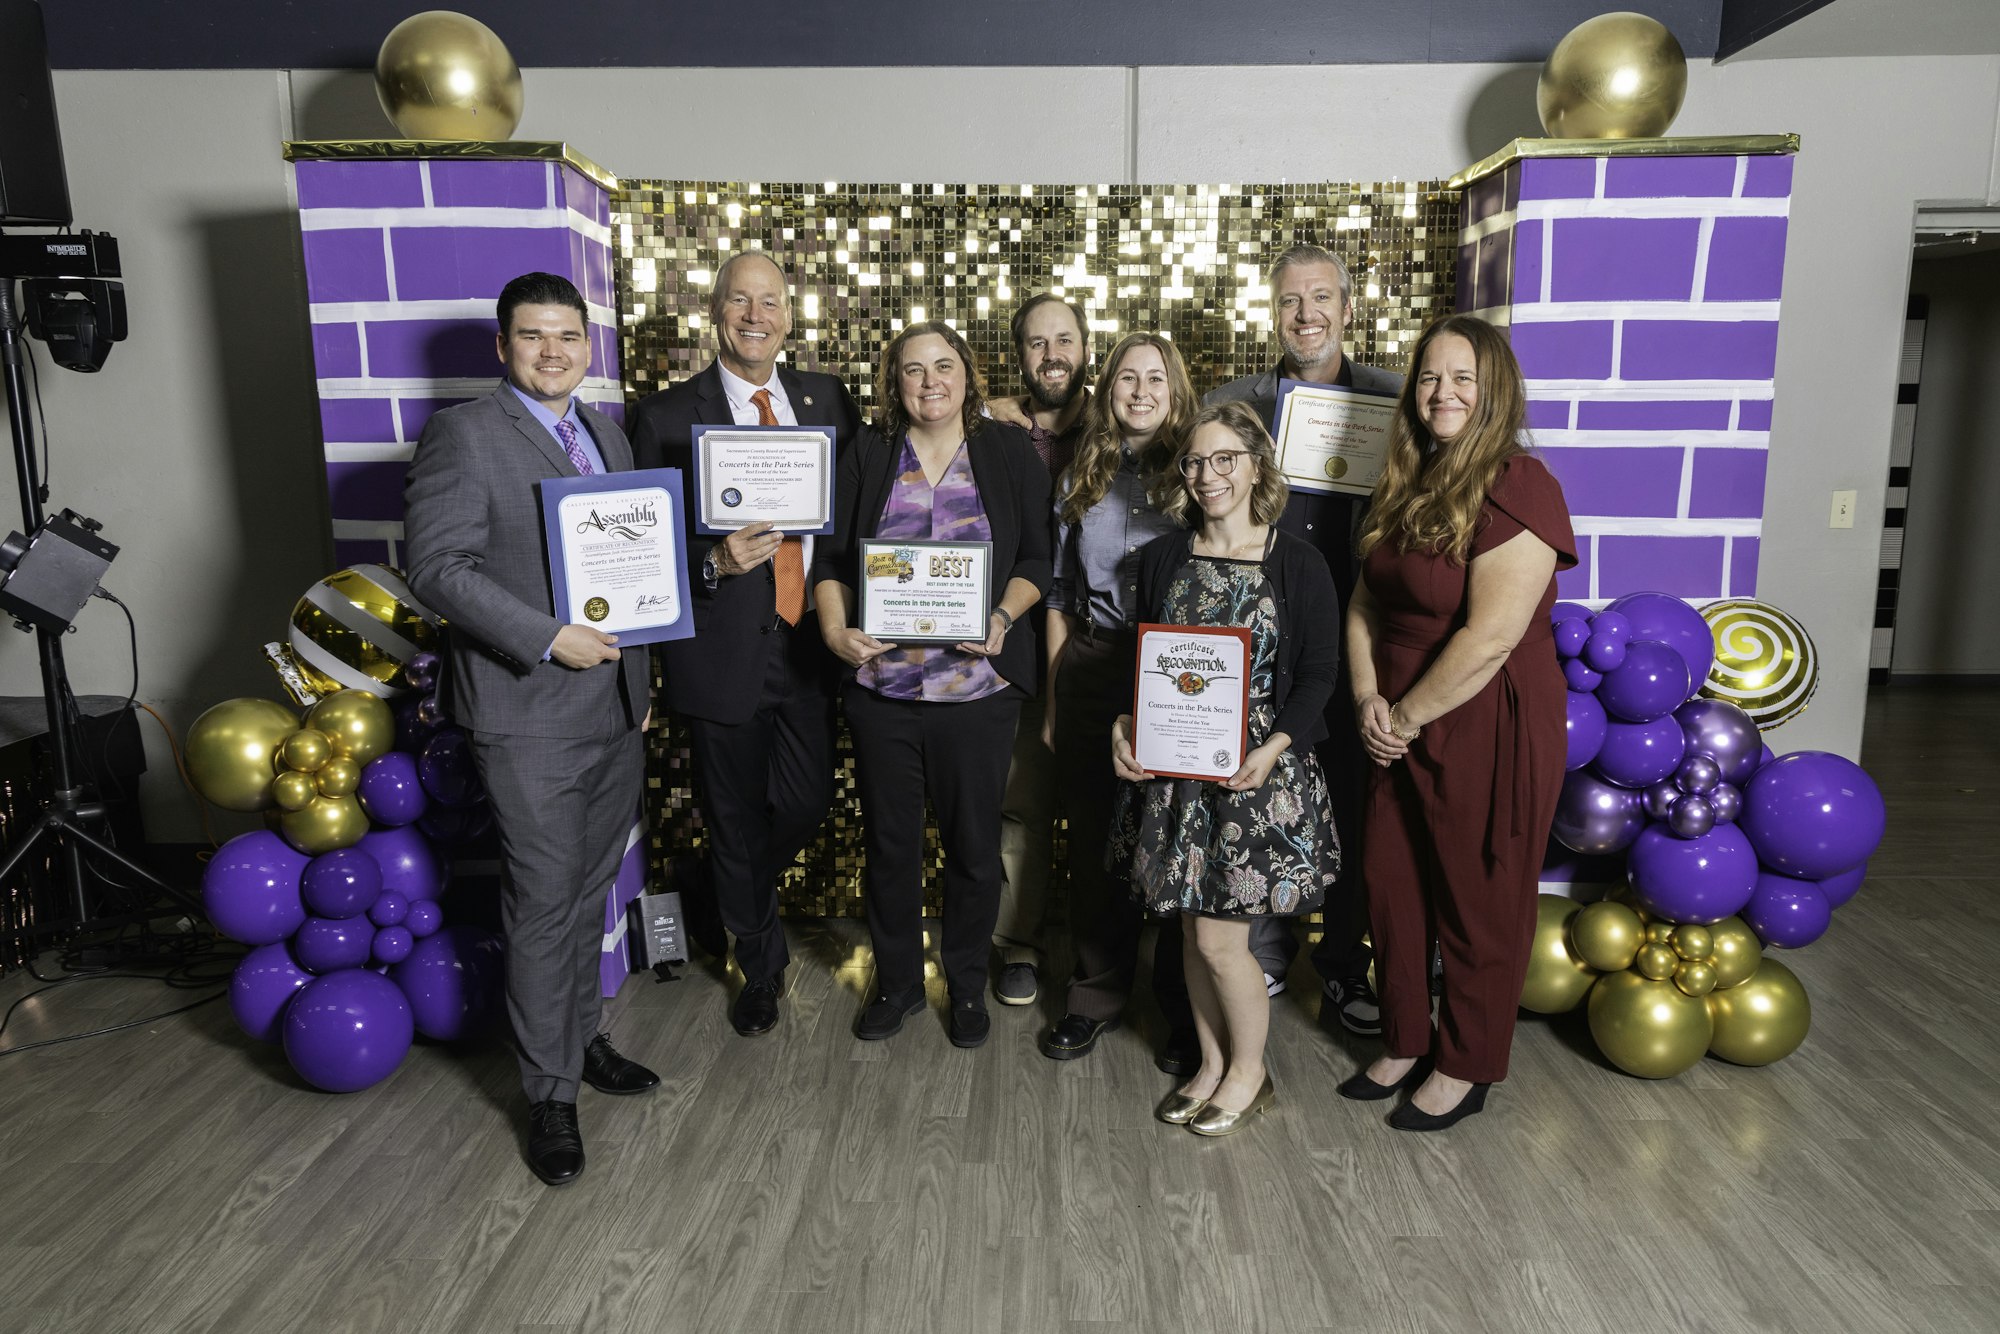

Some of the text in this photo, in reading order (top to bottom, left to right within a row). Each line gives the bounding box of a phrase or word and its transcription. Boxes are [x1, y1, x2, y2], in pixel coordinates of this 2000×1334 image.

[1298, 400, 1326, 408] Certificate
[1308, 418, 1333, 426] Concerts
[1352, 423, 1366, 432] Park
[576, 501, 658, 534] Assembly
[582, 543, 613, 551] CERTIFICATE
[581, 559, 607, 567] Concerts
[868, 560, 908, 575] Carmichael
[929, 555, 973, 578] BEST
[1170, 642, 1215, 655] certificate
[1157, 653, 1227, 673] RECOGNITION
[1148, 701, 1176, 710] Concerts
